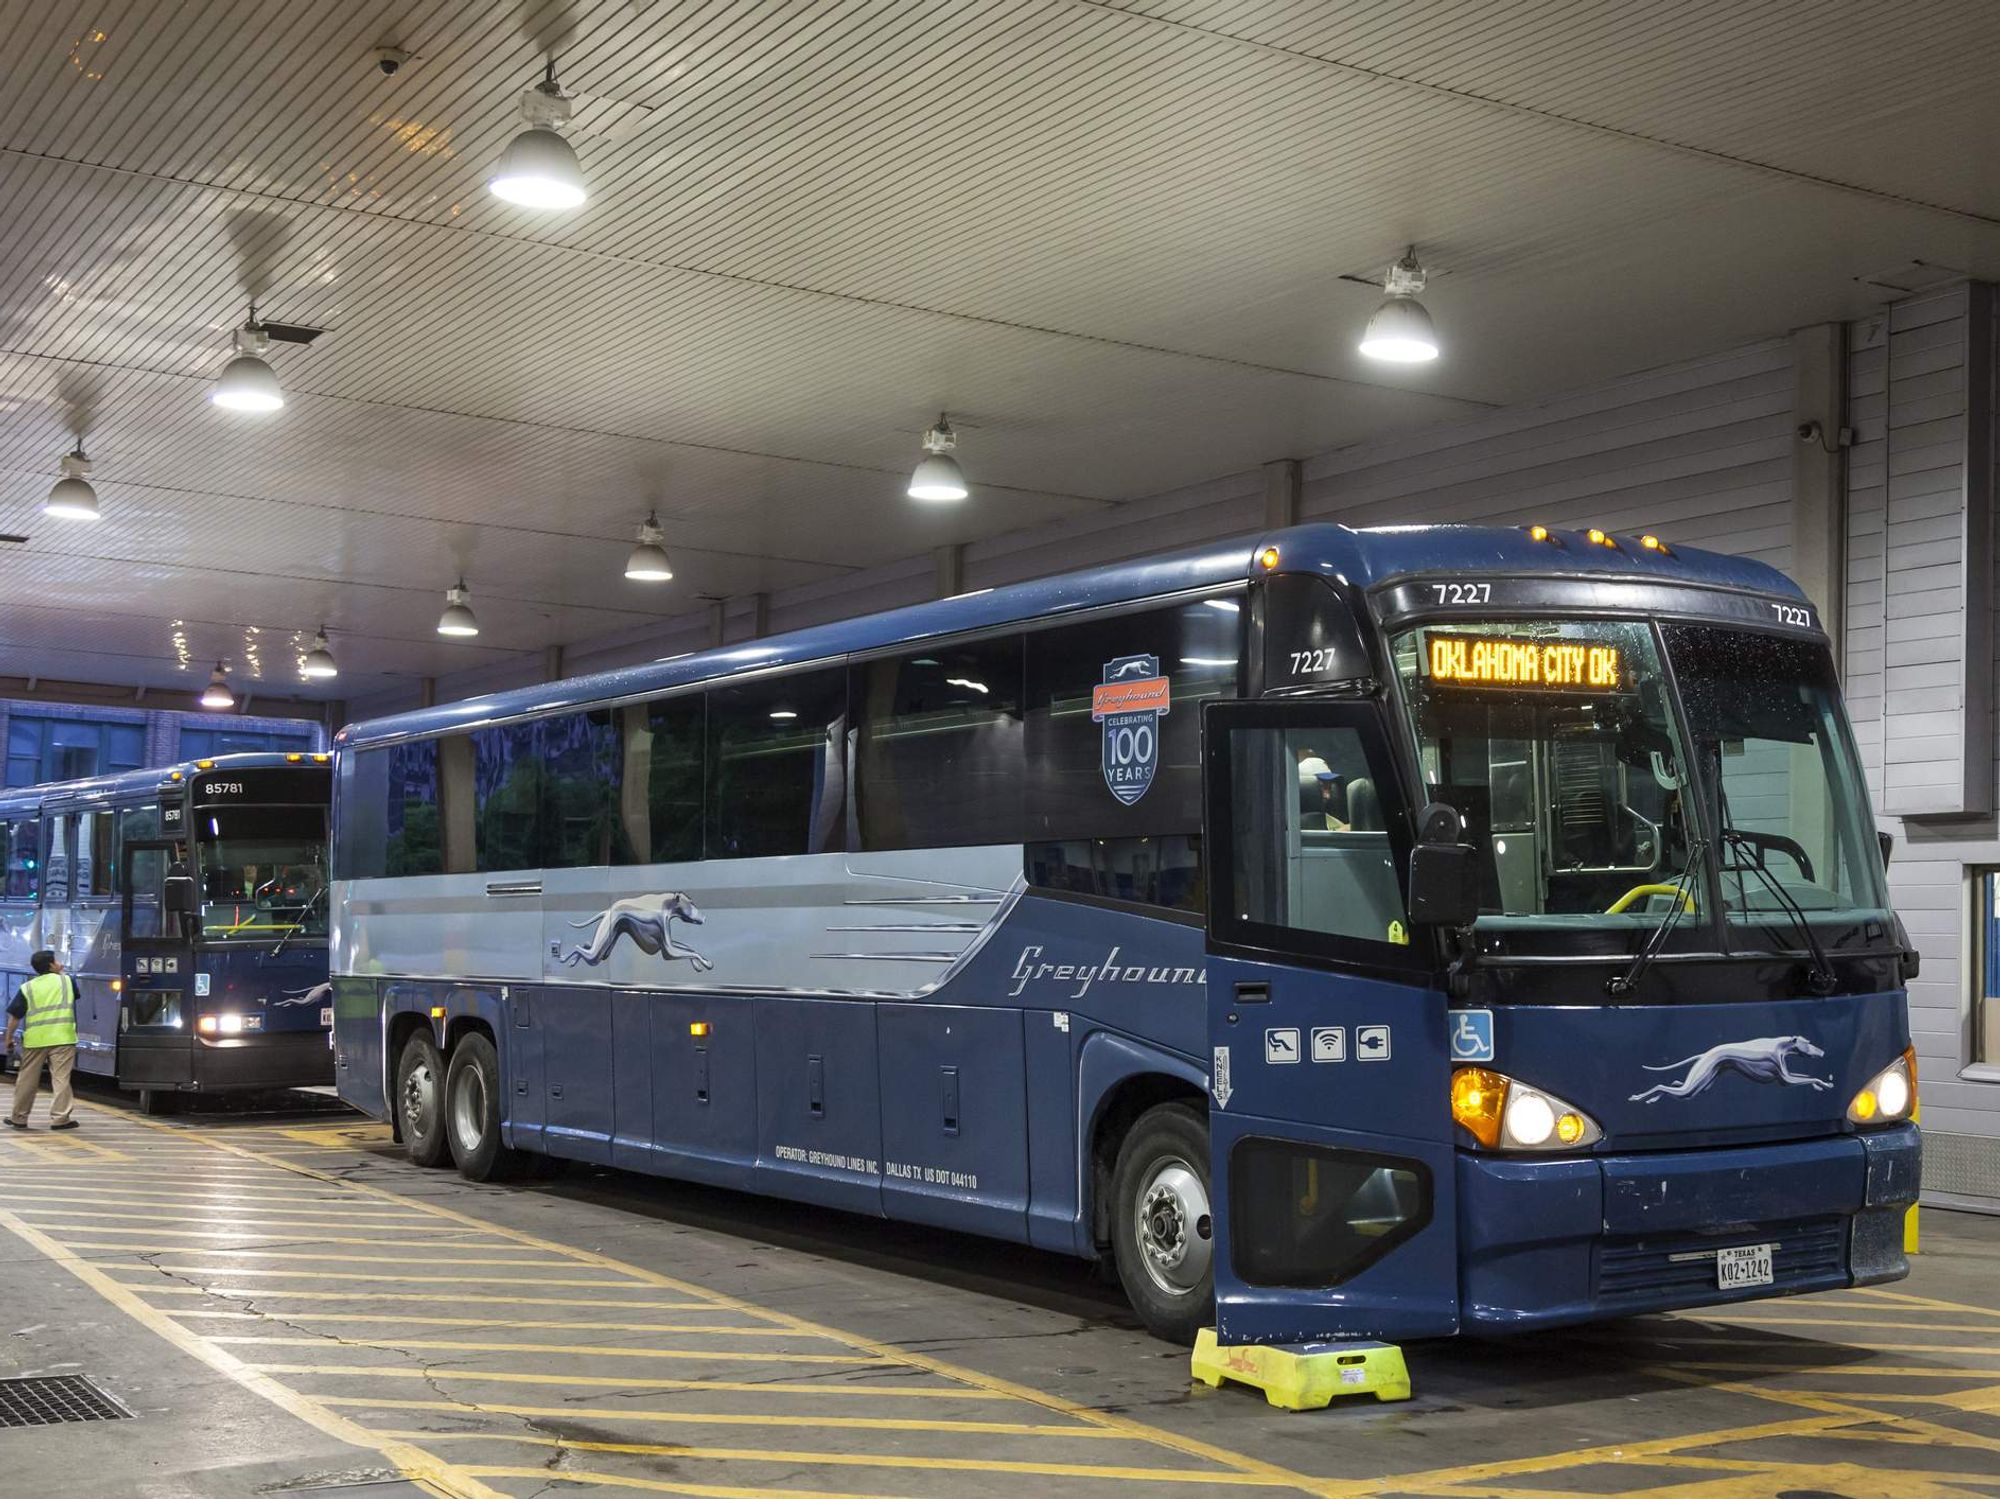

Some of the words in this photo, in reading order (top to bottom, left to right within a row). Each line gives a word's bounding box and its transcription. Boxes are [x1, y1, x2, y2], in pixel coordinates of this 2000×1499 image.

[1432, 583, 1491, 604] 7227
[1771, 604, 1810, 627] 7227
[1290, 648, 1335, 675] 7227
[1432, 640, 1538, 682] OKLAHOMA
[1543, 647, 1585, 684] CITY
[1591, 648, 1617, 686] OK
[1097, 684, 1166, 709] Greyhound
[1108, 714, 1153, 727] CELEBRATING
[1108, 725, 1153, 765] 100
[1108, 766, 1151, 782] YEARS
[205, 783, 243, 794] 85781
[775, 1145, 808, 1162] OPERATOR:
[808, 1150, 846, 1169] GREYHOUND
[847, 1156, 865, 1172] LINES
[866, 1160, 880, 1174] INC.
[886, 1162, 911, 1179] DALLAS
[912, 1166, 921, 1180] TX
[924, 1167, 935, 1182] US
[936, 1169, 950, 1184] DOT
[951, 1172, 977, 1189] 044110
[1734, 1248, 1756, 1258] TEXAS
